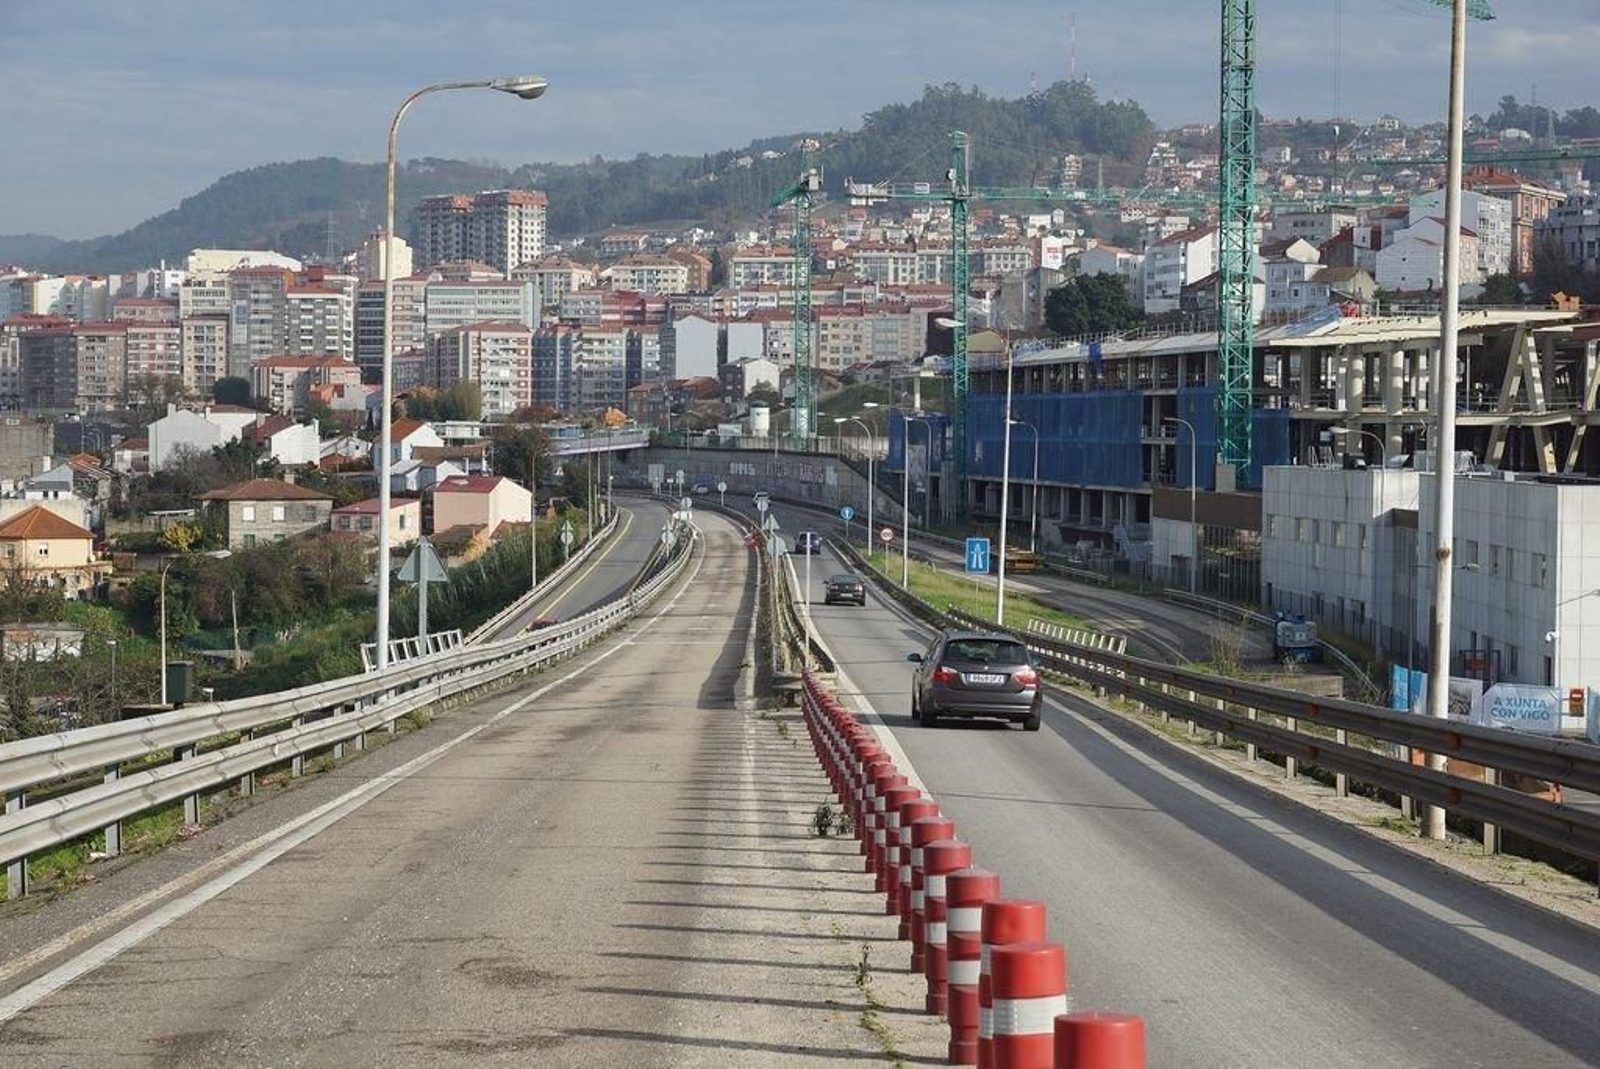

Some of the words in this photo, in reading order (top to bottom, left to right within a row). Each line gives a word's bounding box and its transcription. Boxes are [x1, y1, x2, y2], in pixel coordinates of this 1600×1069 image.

[1494, 697, 1502, 706] A
[1505, 697, 1547, 709] XUNTA
[1490, 707, 1516, 718] CON
[1519, 709, 1550, 720] VIGO
